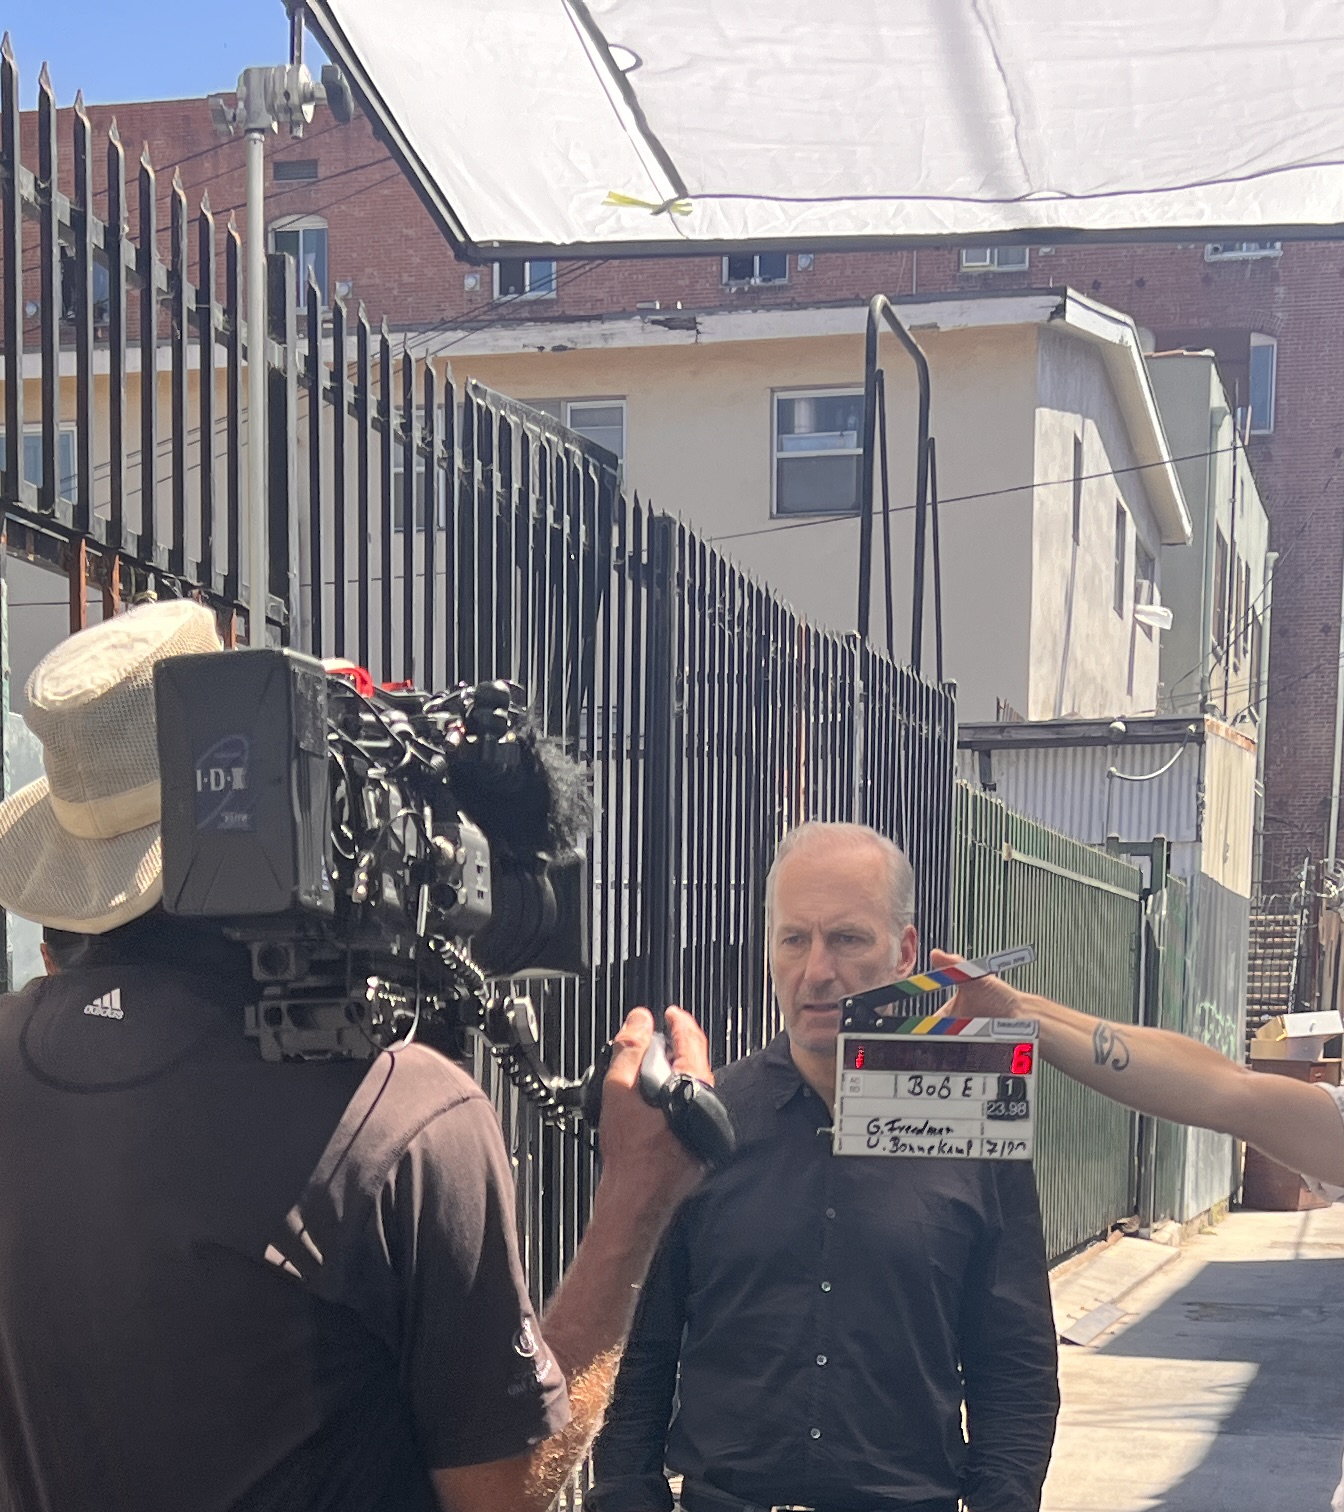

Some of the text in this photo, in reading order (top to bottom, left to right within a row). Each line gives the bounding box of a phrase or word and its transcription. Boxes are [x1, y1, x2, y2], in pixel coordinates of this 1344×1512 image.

[83, 1004, 124, 1020] adidas
[1010, 1042, 1033, 1075] 6
[961, 1077, 974, 1098] E
[1005, 1078, 1014, 1097] 1
